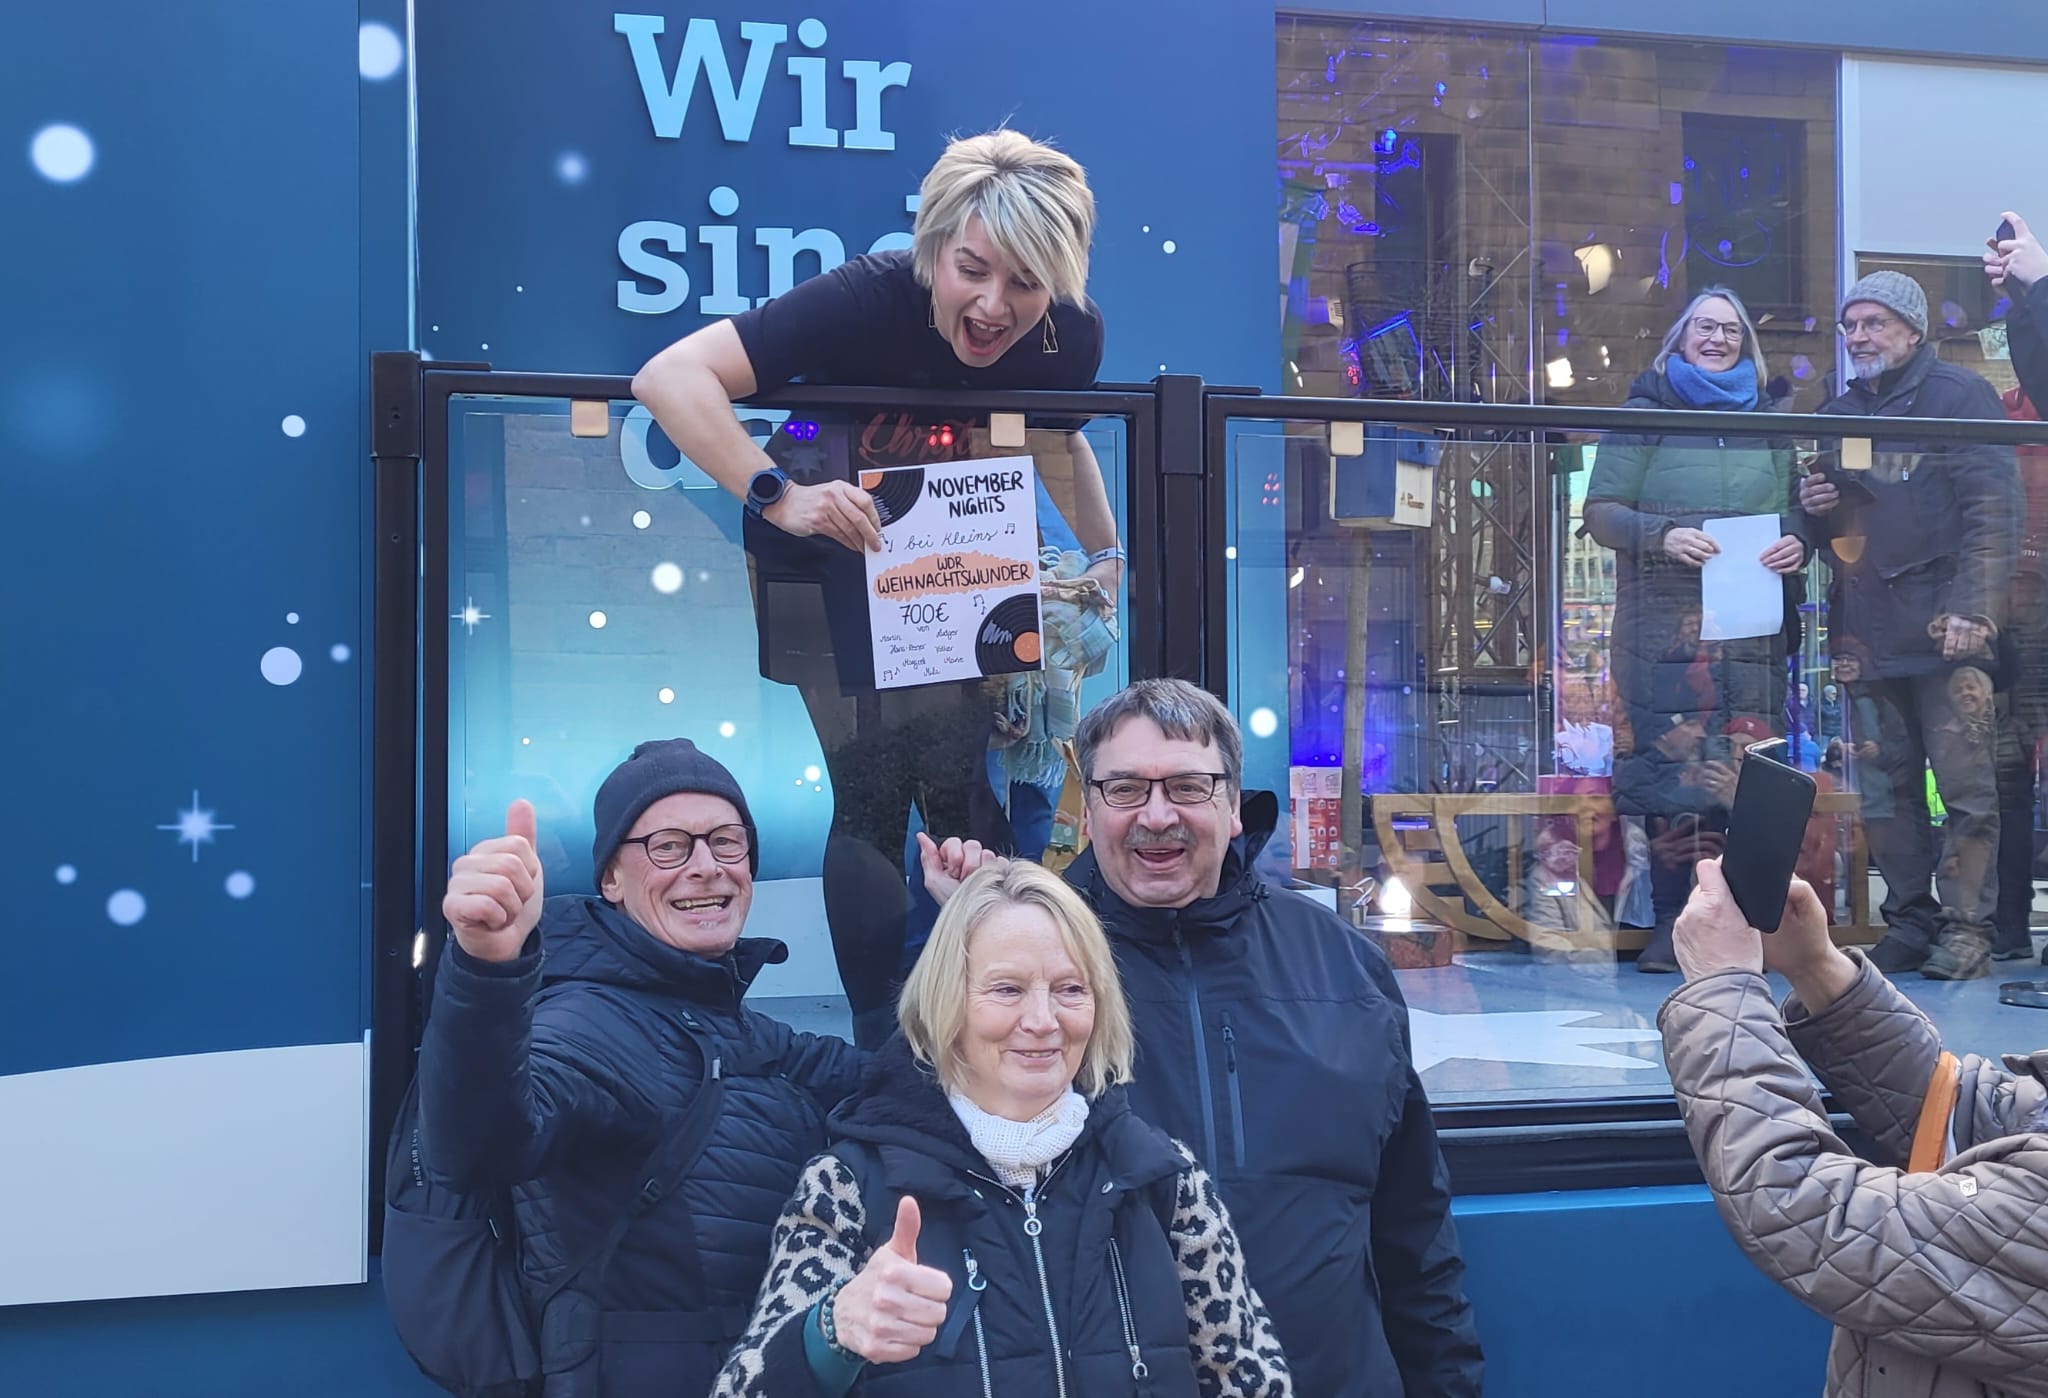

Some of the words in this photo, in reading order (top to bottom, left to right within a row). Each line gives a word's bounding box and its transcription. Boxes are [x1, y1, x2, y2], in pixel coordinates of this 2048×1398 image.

[614, 13, 912, 151] Wir
[928, 470, 1024, 498] NOVEMBER
[949, 495, 1005, 518] NIGHTS
[904, 534, 934, 550] bei
[941, 528, 998, 546] Kleins
[936, 556, 965, 571] WDR
[877, 563, 1031, 594] WEIHNACHTSWUNDER
[899, 602, 949, 625] 700€
[916, 625, 930, 633] von
